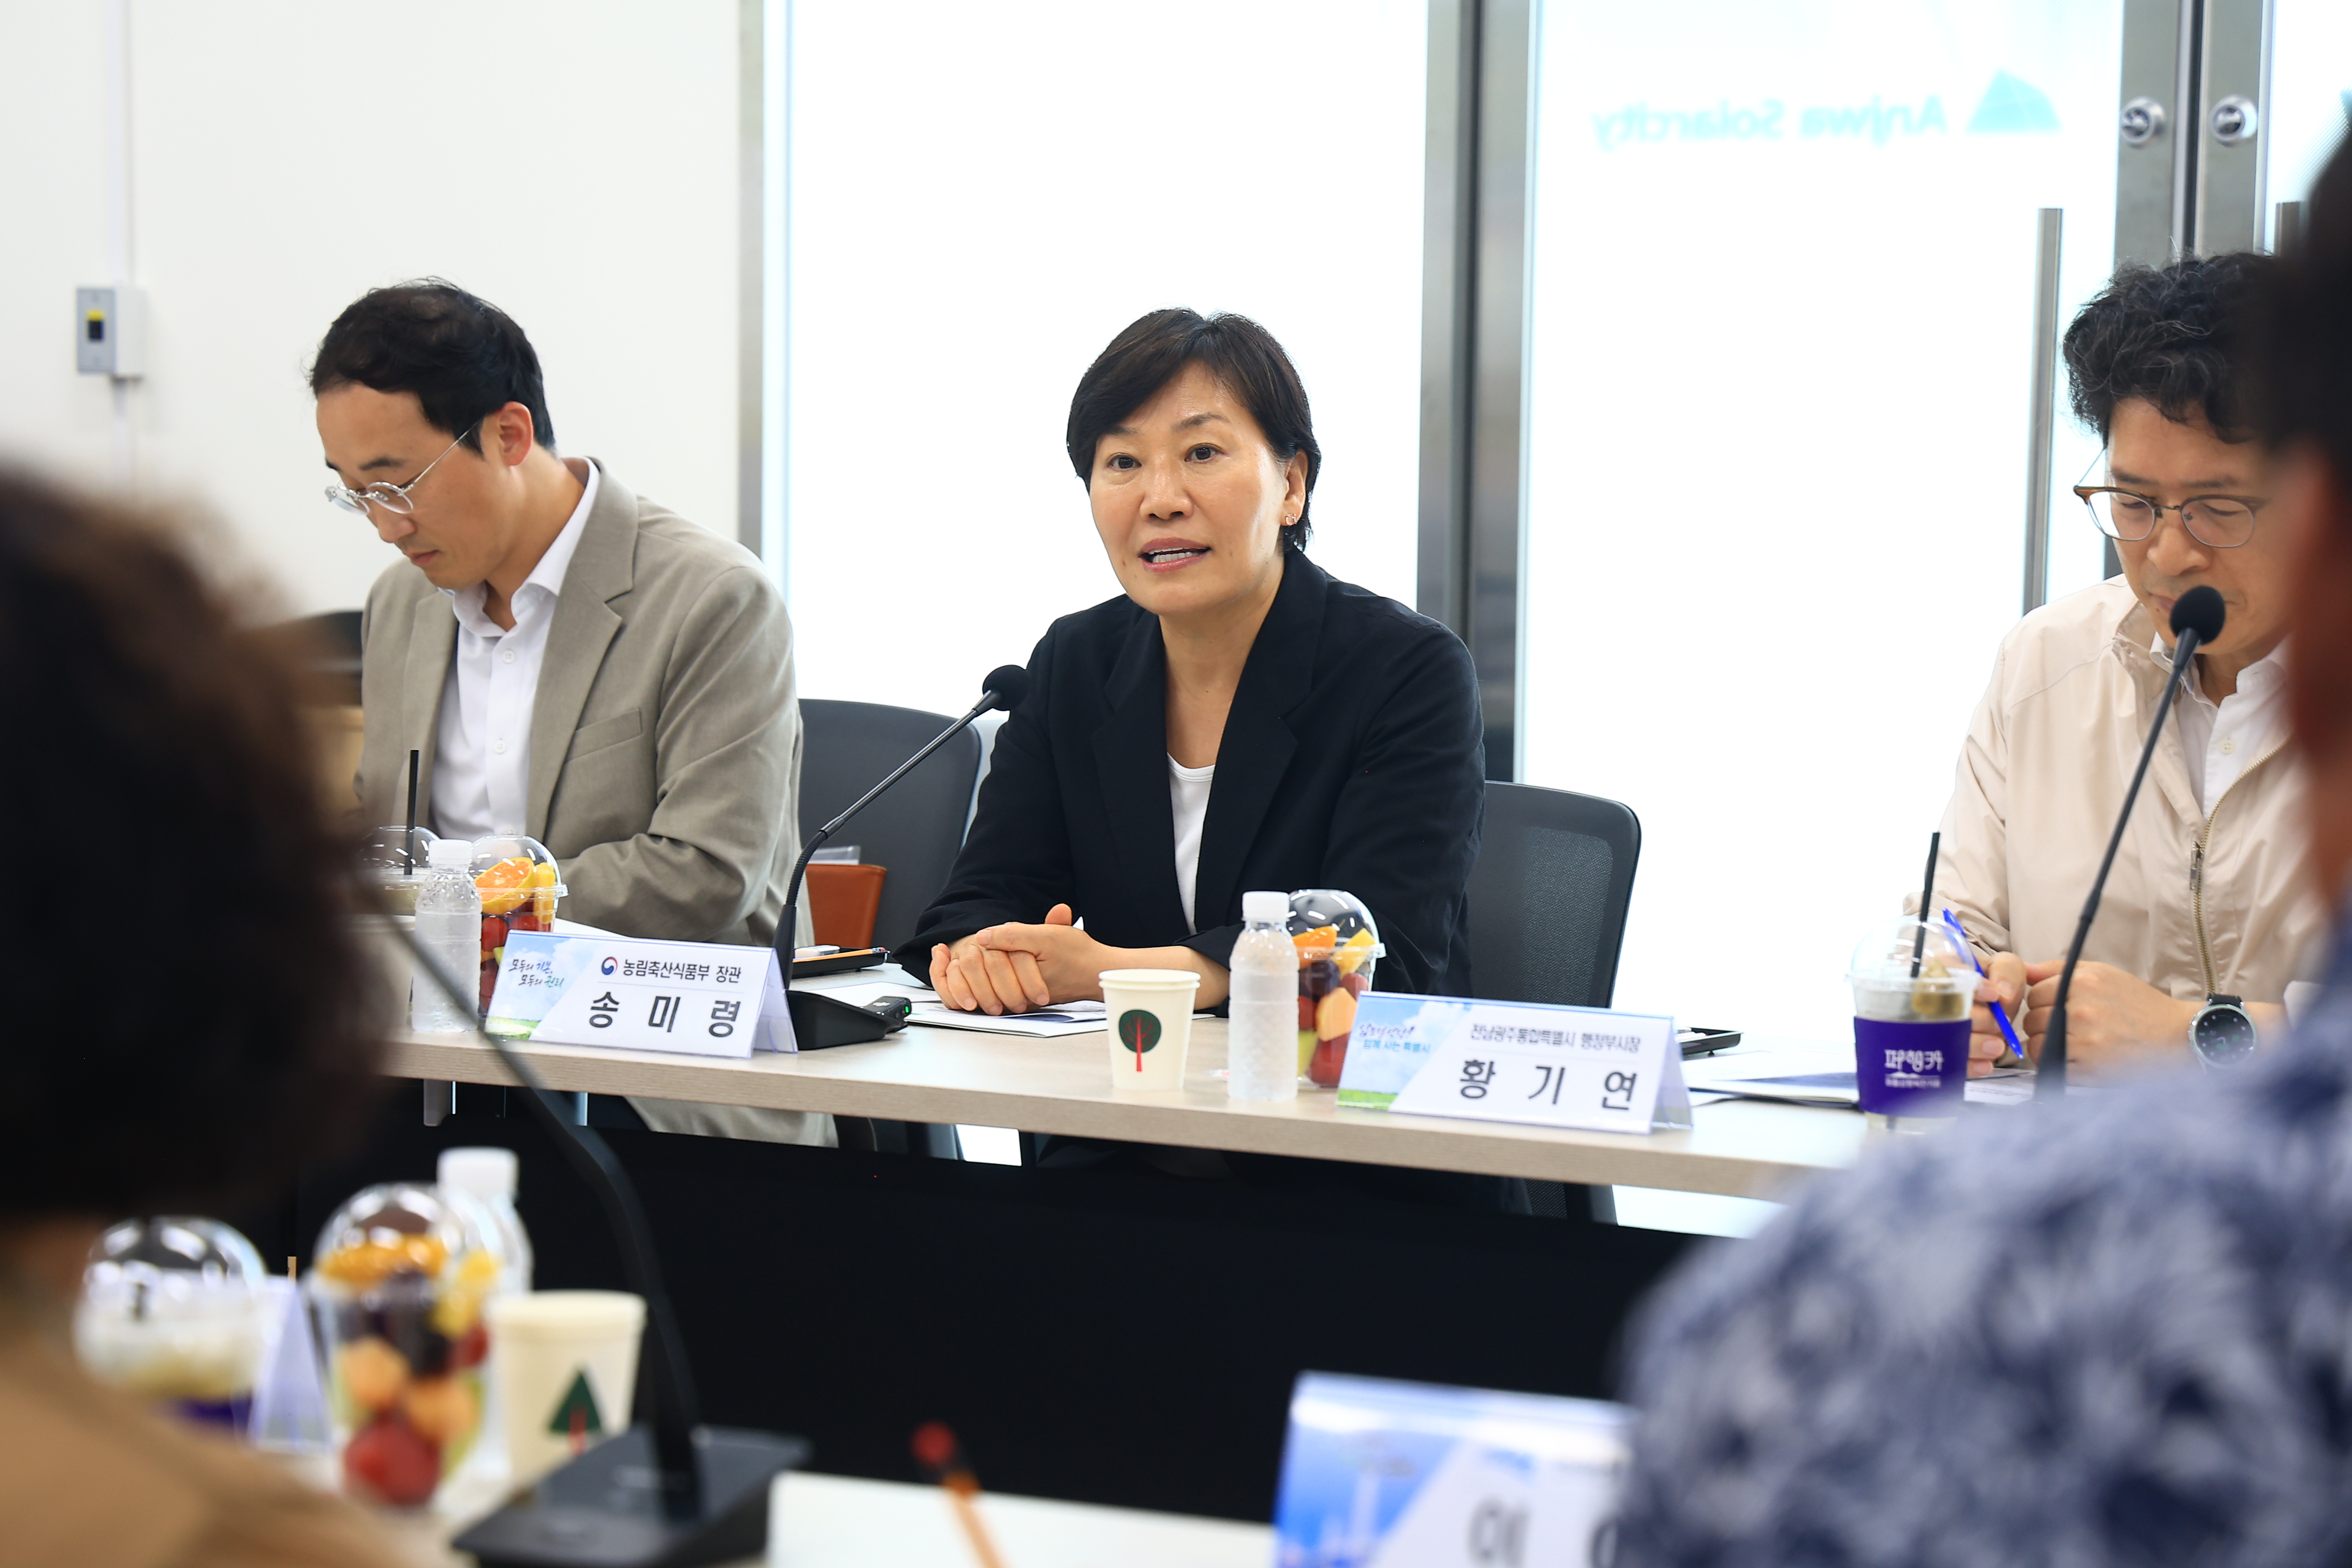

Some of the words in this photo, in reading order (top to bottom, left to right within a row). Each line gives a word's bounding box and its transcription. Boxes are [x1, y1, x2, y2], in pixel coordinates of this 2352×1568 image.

[508, 959, 533, 972] 모두의
[623, 959, 710, 981] 농림축산식품부
[716, 965, 741, 984] 장관
[518, 974, 543, 986] 모두의
[1471, 1023, 1576, 1047] 전남광주통합특별시
[1581, 1033, 1641, 1053] 행정부시장
